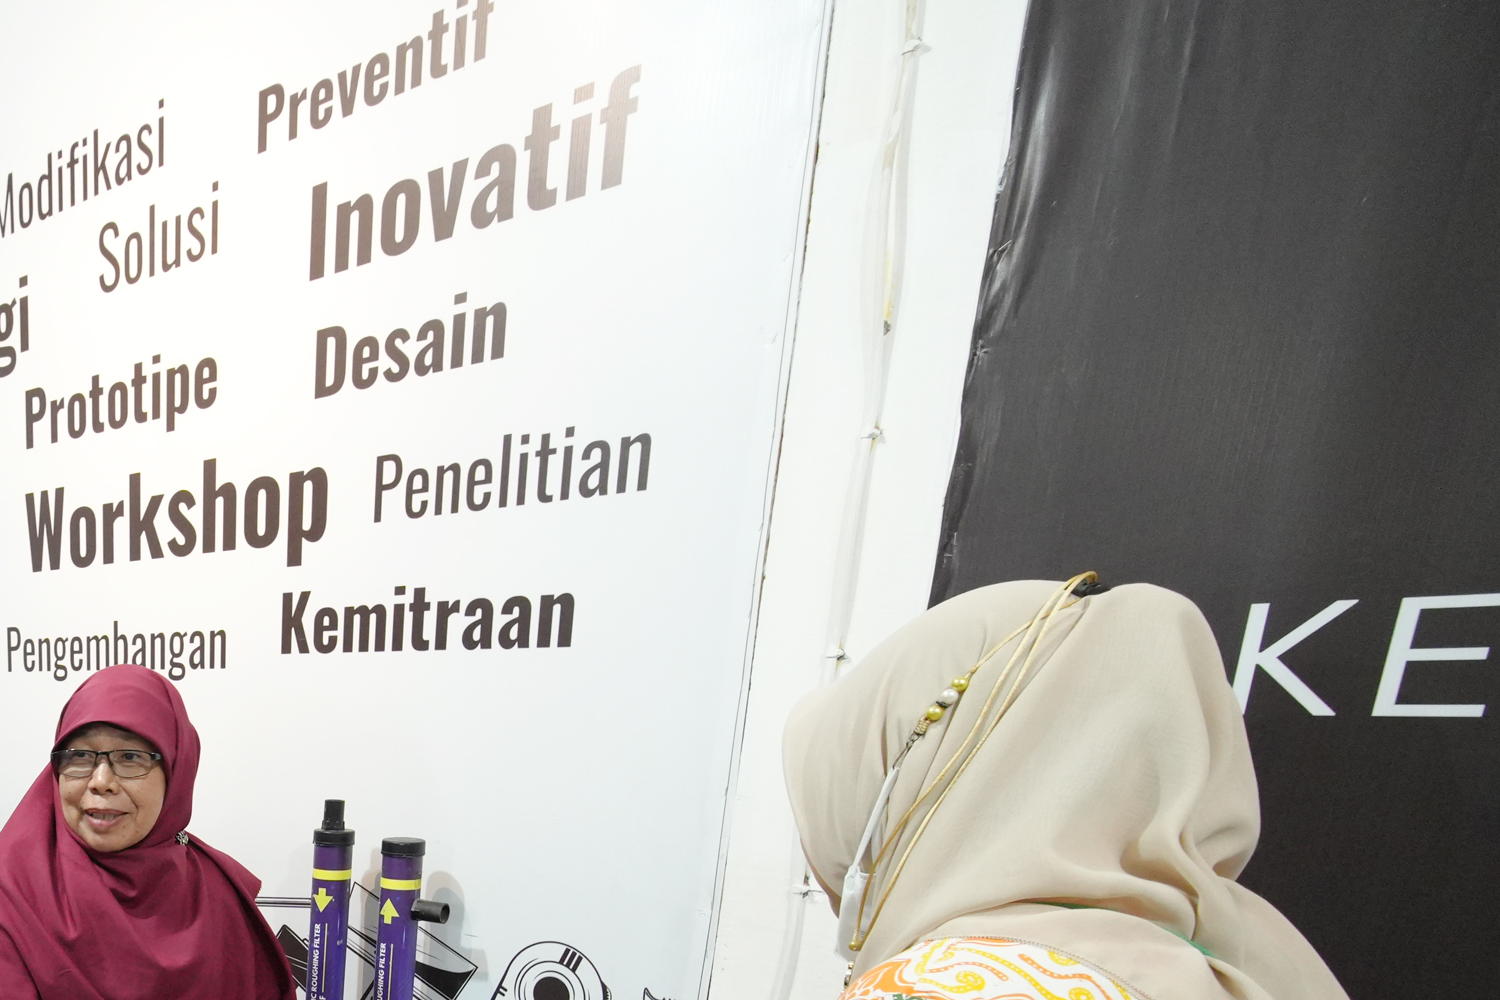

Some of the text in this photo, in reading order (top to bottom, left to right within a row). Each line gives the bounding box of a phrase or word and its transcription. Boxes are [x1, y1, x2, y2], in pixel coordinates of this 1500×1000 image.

[258, 0, 494, 154] Preventif
[309, 63, 642, 282] Inovatif
[99, 183, 219, 293] Solusi
[314, 291, 507, 400] Desain
[25, 354, 218, 450] Prototipe
[25, 458, 328, 573] Workshop
[373, 426, 652, 524] Penelitian
[6, 620, 226, 682] Pengembangan
[280, 586, 576, 655] Kemitraan
[1232, 592, 1500, 717] KE
[311, 949, 320, 994] ROUGHING
[314, 923, 322, 949] FILTER
[379, 942, 388, 969] FILTER
